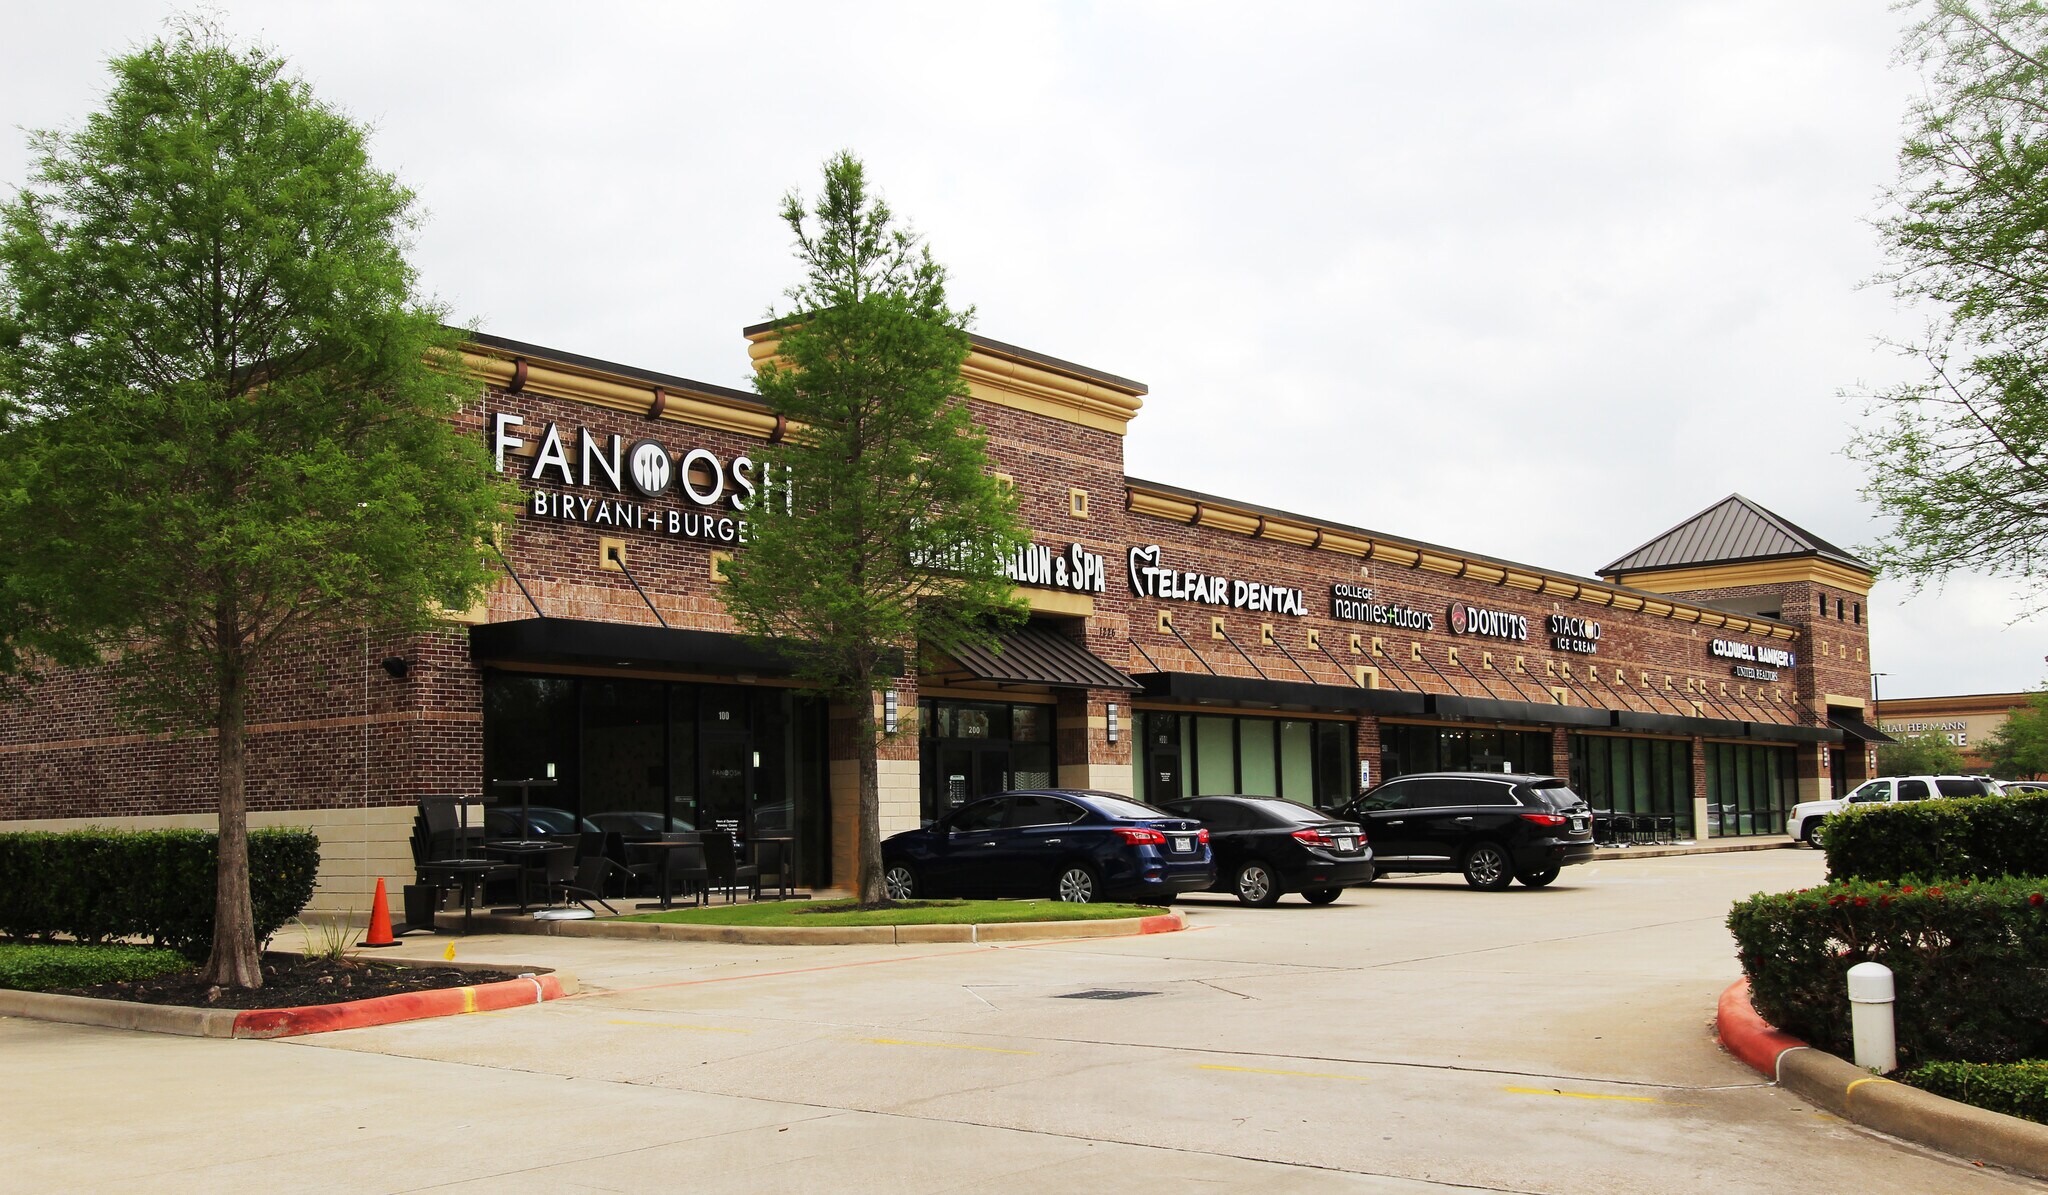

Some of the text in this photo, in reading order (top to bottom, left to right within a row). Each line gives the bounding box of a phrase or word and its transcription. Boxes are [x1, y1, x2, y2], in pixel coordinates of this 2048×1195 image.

[1056, 556, 1069, 587] &
[1072, 542, 1106, 593] SPA
[1143, 567, 1307, 615] TELFAIR DENTAL
[1335, 584, 1373, 600] COLLEGE
[1468, 607, 1527, 640] DONUTS
[1557, 637, 1597, 654] ICE CREAM
[718, 711, 730, 721] 100
[968, 726, 981, 734] 200
[1880, 721, 1967, 733] RIAL HERMANN
